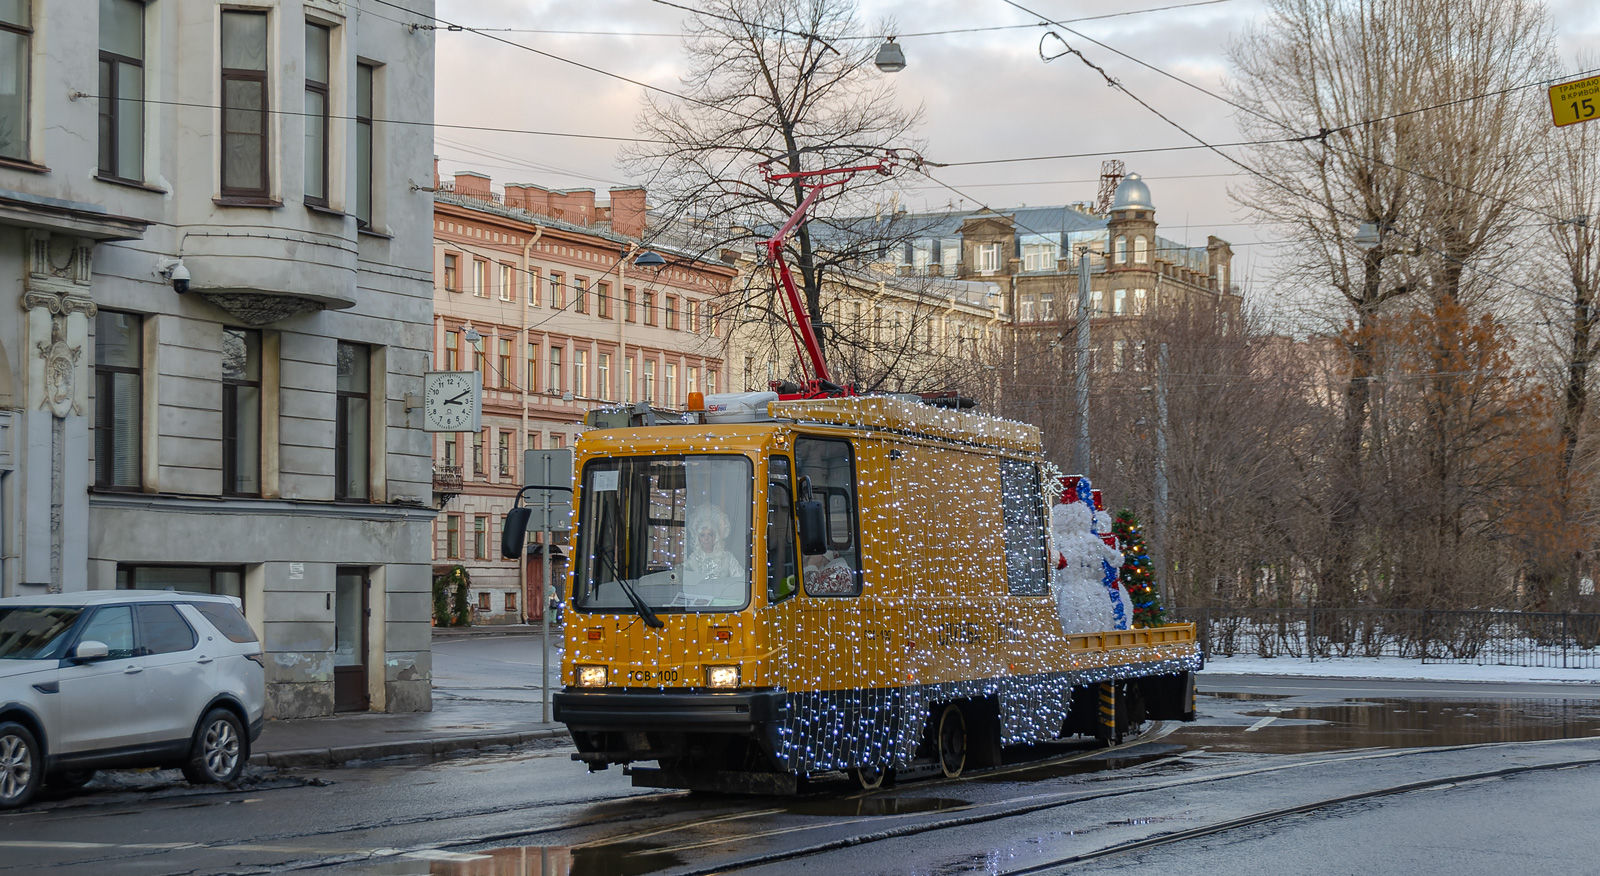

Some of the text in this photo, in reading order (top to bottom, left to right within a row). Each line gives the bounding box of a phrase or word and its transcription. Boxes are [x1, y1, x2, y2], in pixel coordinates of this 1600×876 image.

[1559, 79, 1599, 93] ТРАМВАЮ
[1567, 86, 1600, 99] КРИВОЙ
[1571, 98, 1595, 120] 15
